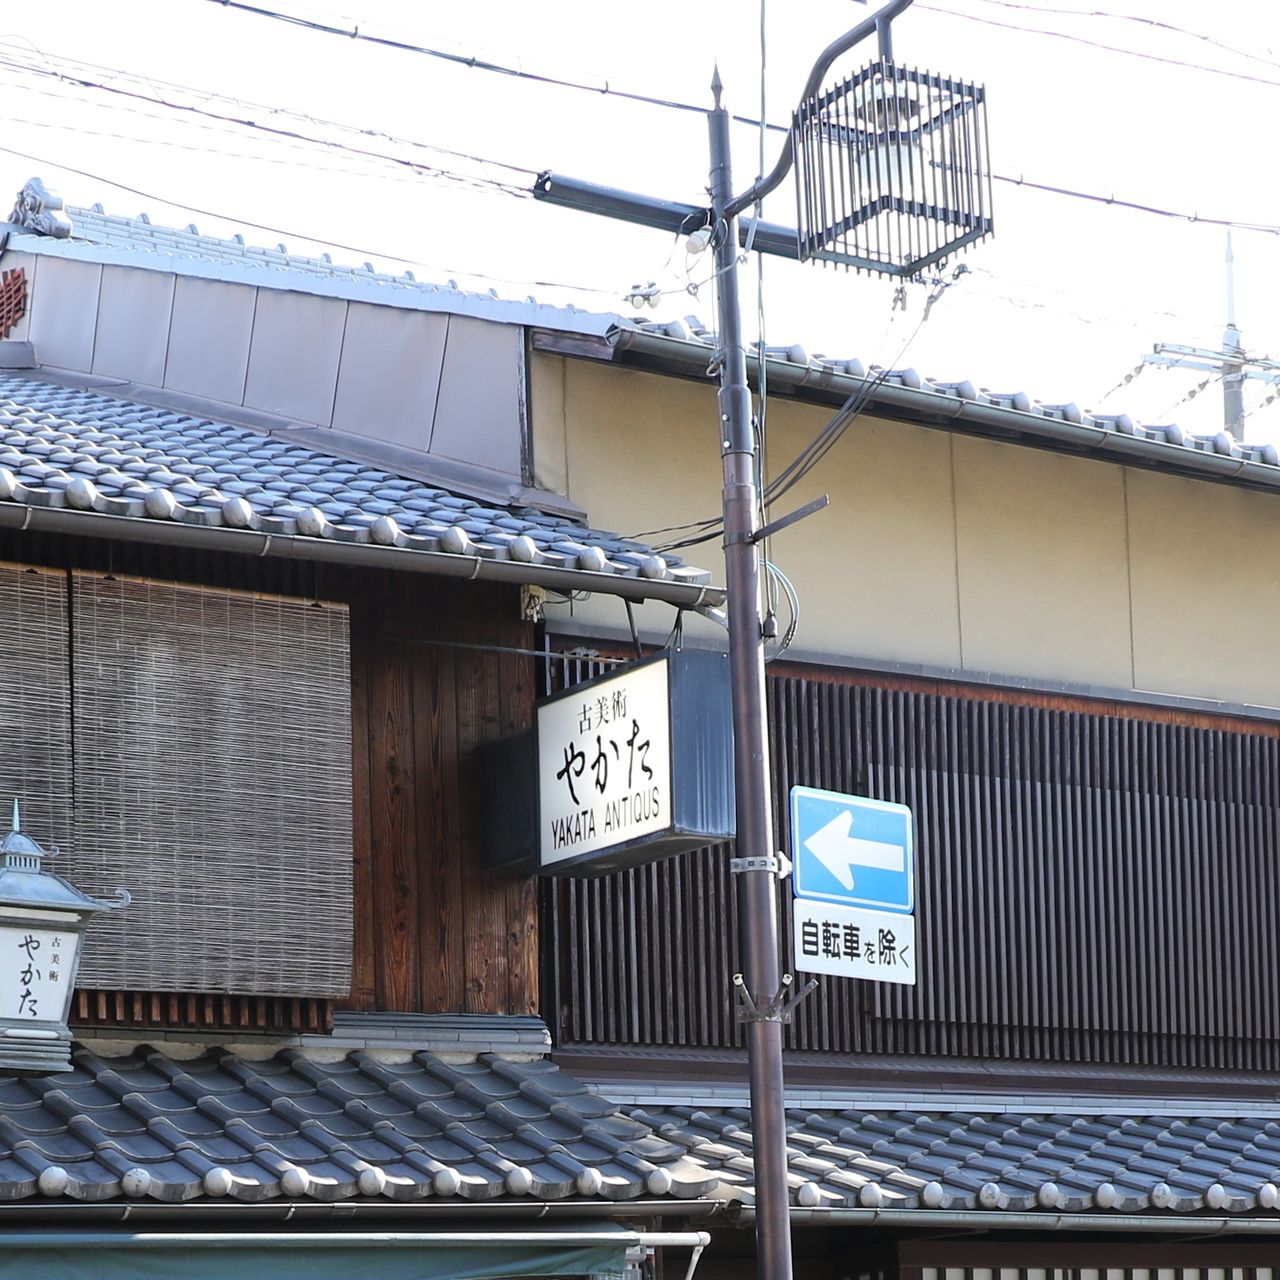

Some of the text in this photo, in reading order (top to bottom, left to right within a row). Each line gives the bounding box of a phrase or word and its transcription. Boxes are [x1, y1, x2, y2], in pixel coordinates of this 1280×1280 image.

[577, 688, 628, 735] 古美術
[556, 718, 653, 806] やかた
[551, 786, 660, 850] YAKATA ANTIQUS
[49, 936, 61, 982] 古美術
[801, 918, 910, 969] 自転車を除く
[18, 934, 41, 1017] やかた
